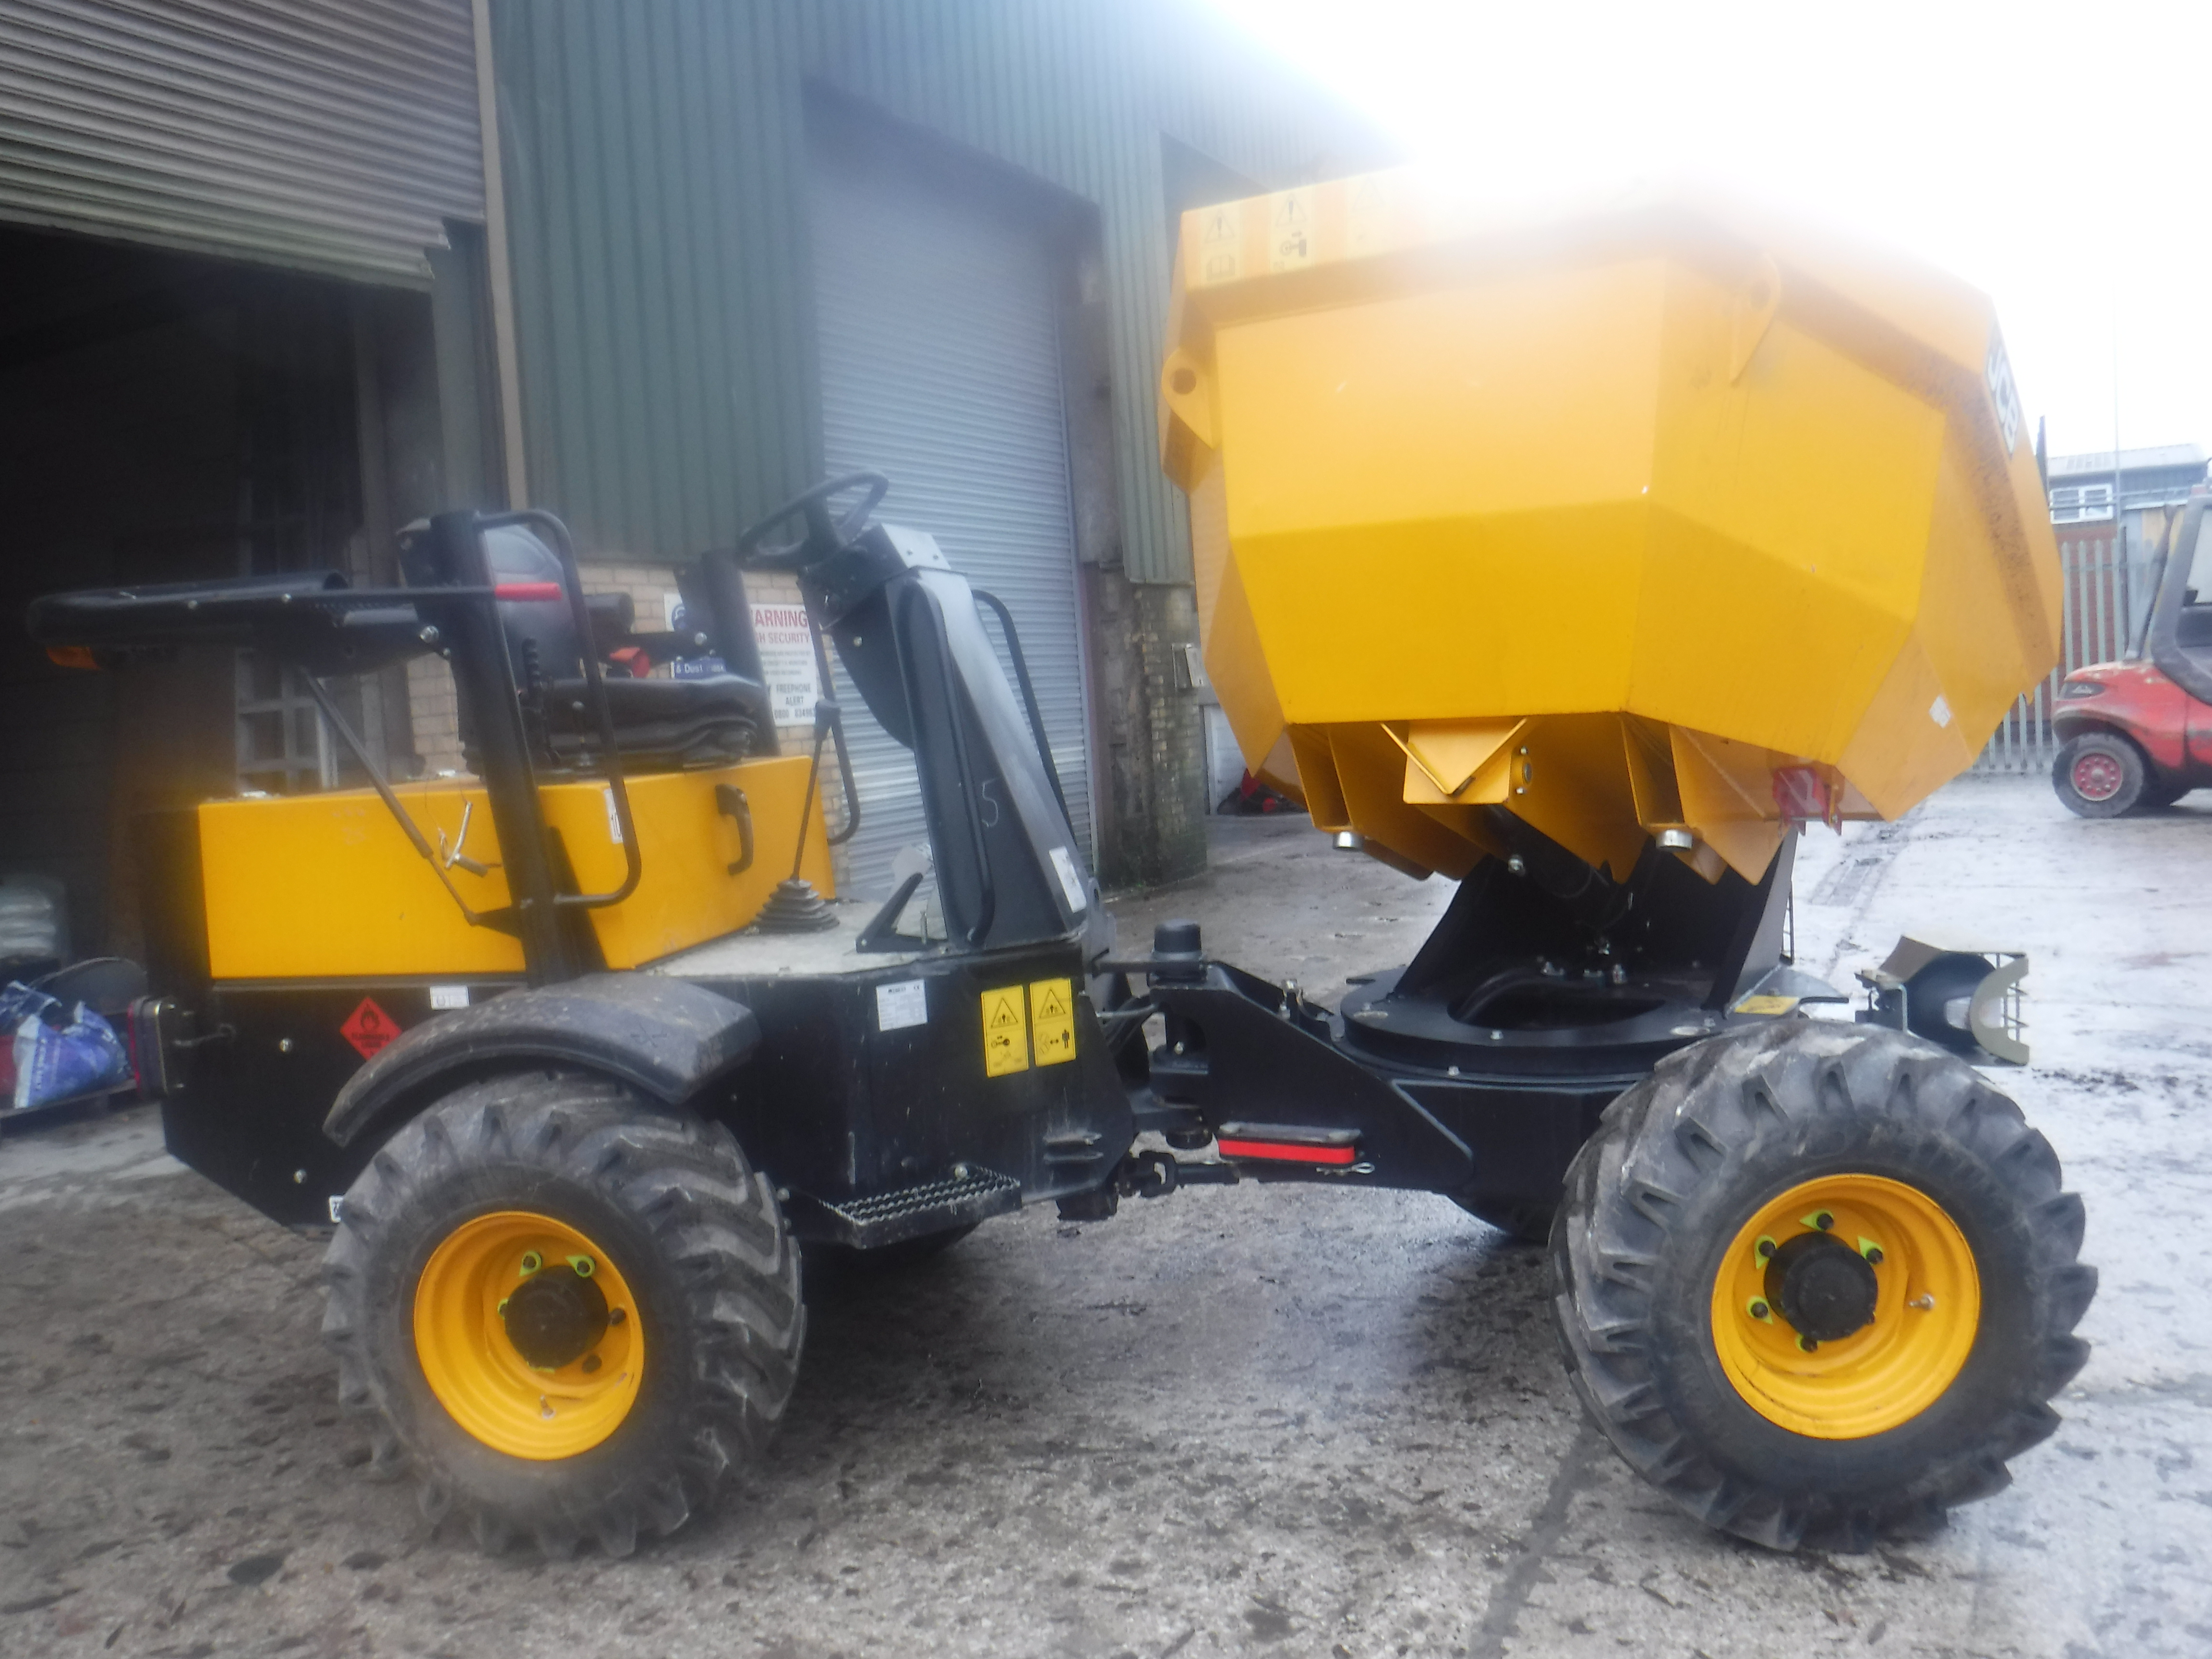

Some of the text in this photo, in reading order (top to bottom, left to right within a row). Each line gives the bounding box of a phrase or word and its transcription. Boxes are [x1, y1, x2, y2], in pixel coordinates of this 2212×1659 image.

[751, 610, 808, 627] ARNING
[769, 632, 809, 644] SECURITY
[684, 663, 703, 673] Dust
[776, 684, 811, 693] FREEPHONE
[786, 696, 804, 706] ALERT
